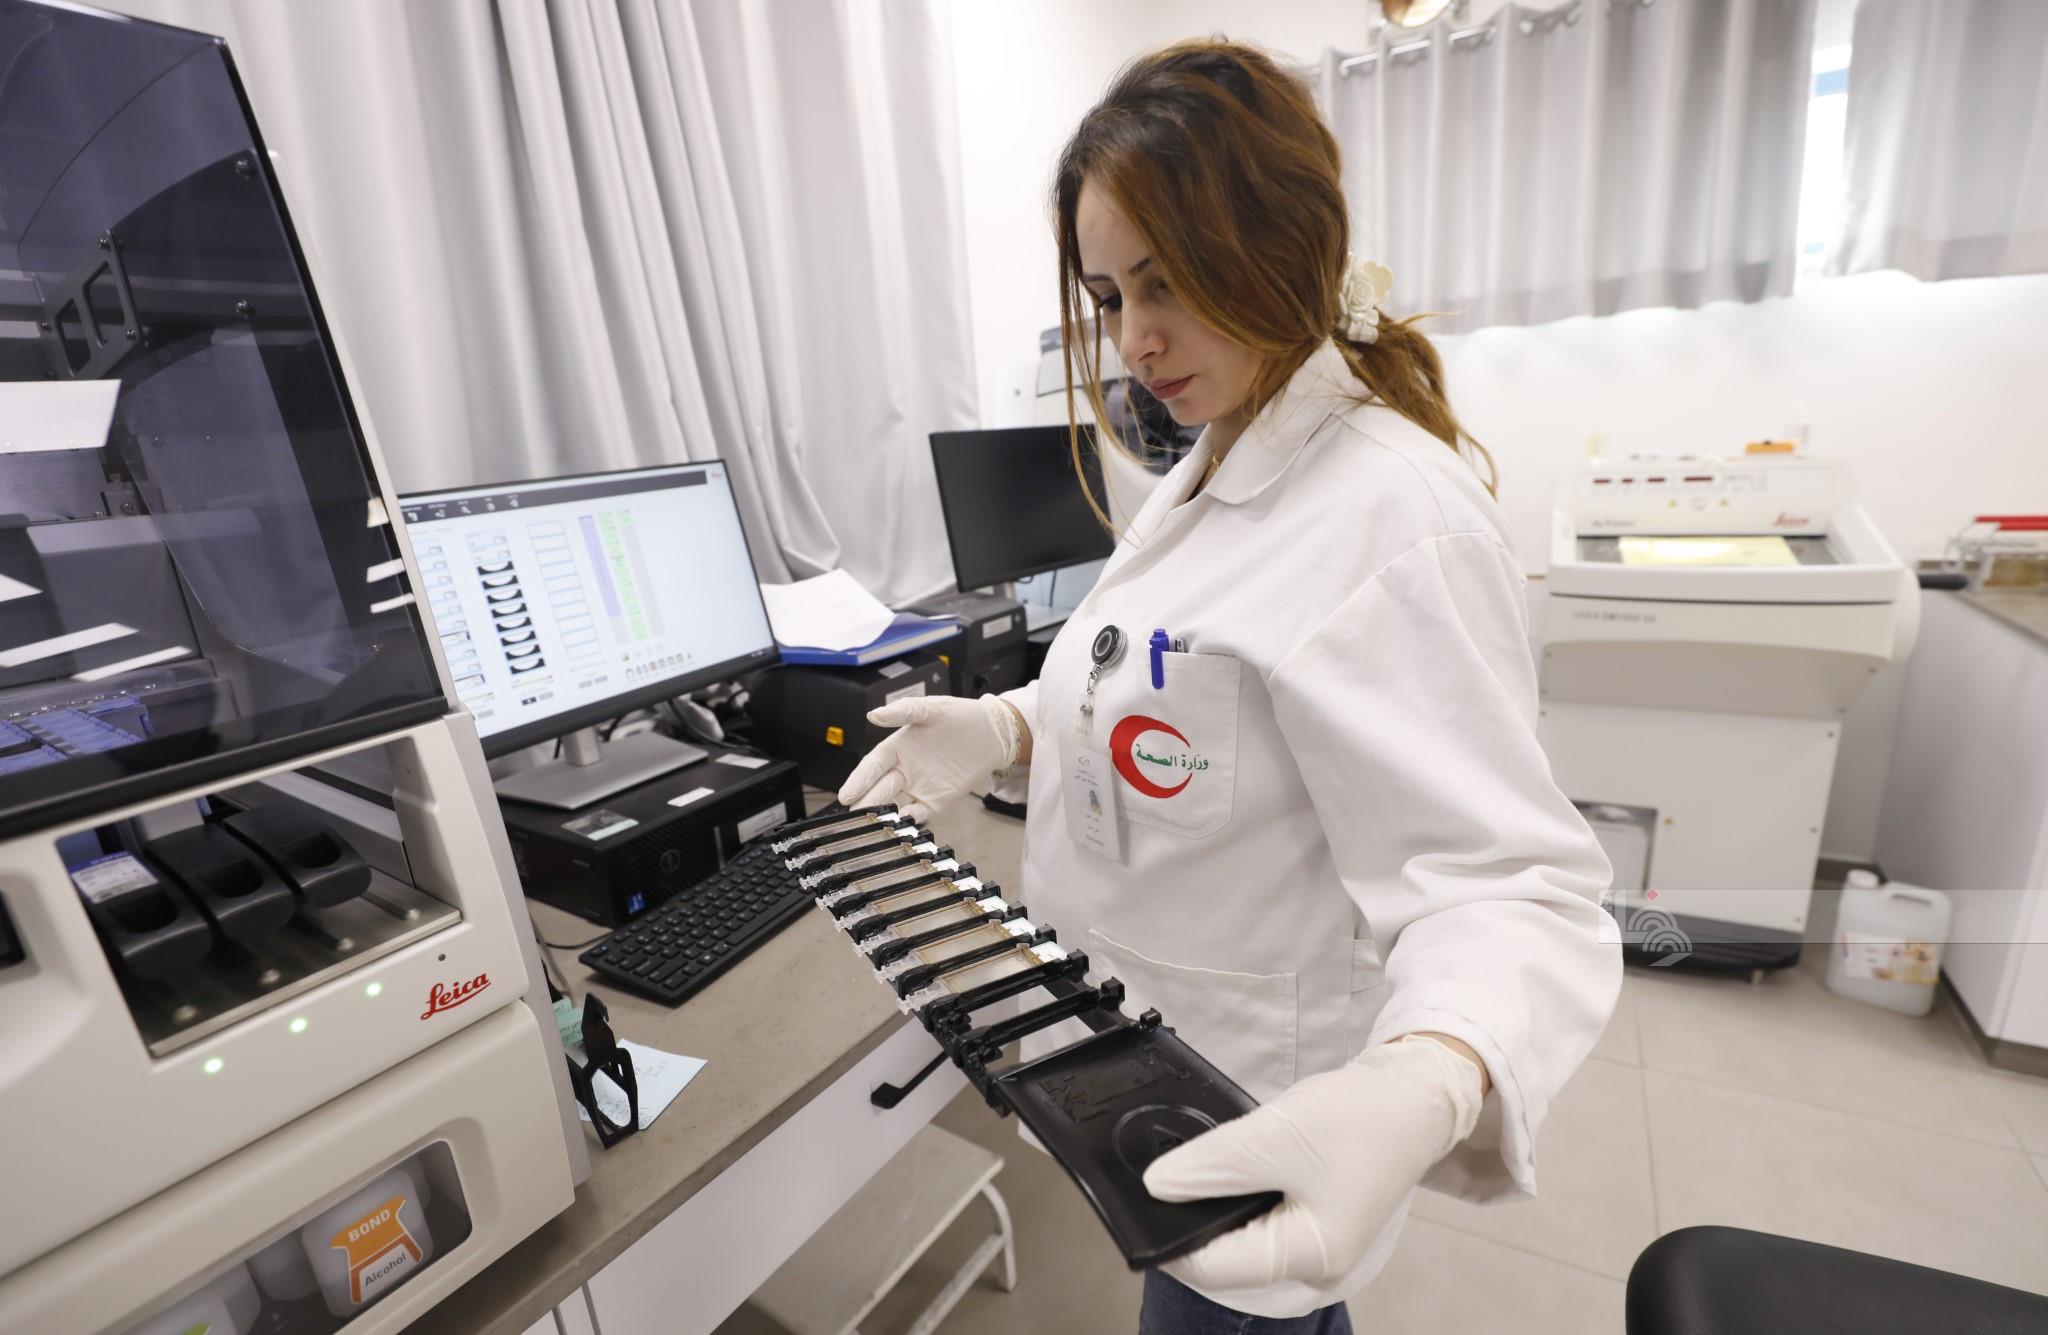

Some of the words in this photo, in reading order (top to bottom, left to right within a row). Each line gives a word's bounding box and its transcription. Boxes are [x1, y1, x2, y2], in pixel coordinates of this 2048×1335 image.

[1136, 743, 1177, 767] الصحة
[1181, 753, 1209, 771] وزارة
[420, 973, 491, 1020] Leica
[348, 1209, 391, 1242] BOND
[364, 1252, 407, 1287] Alcohol
